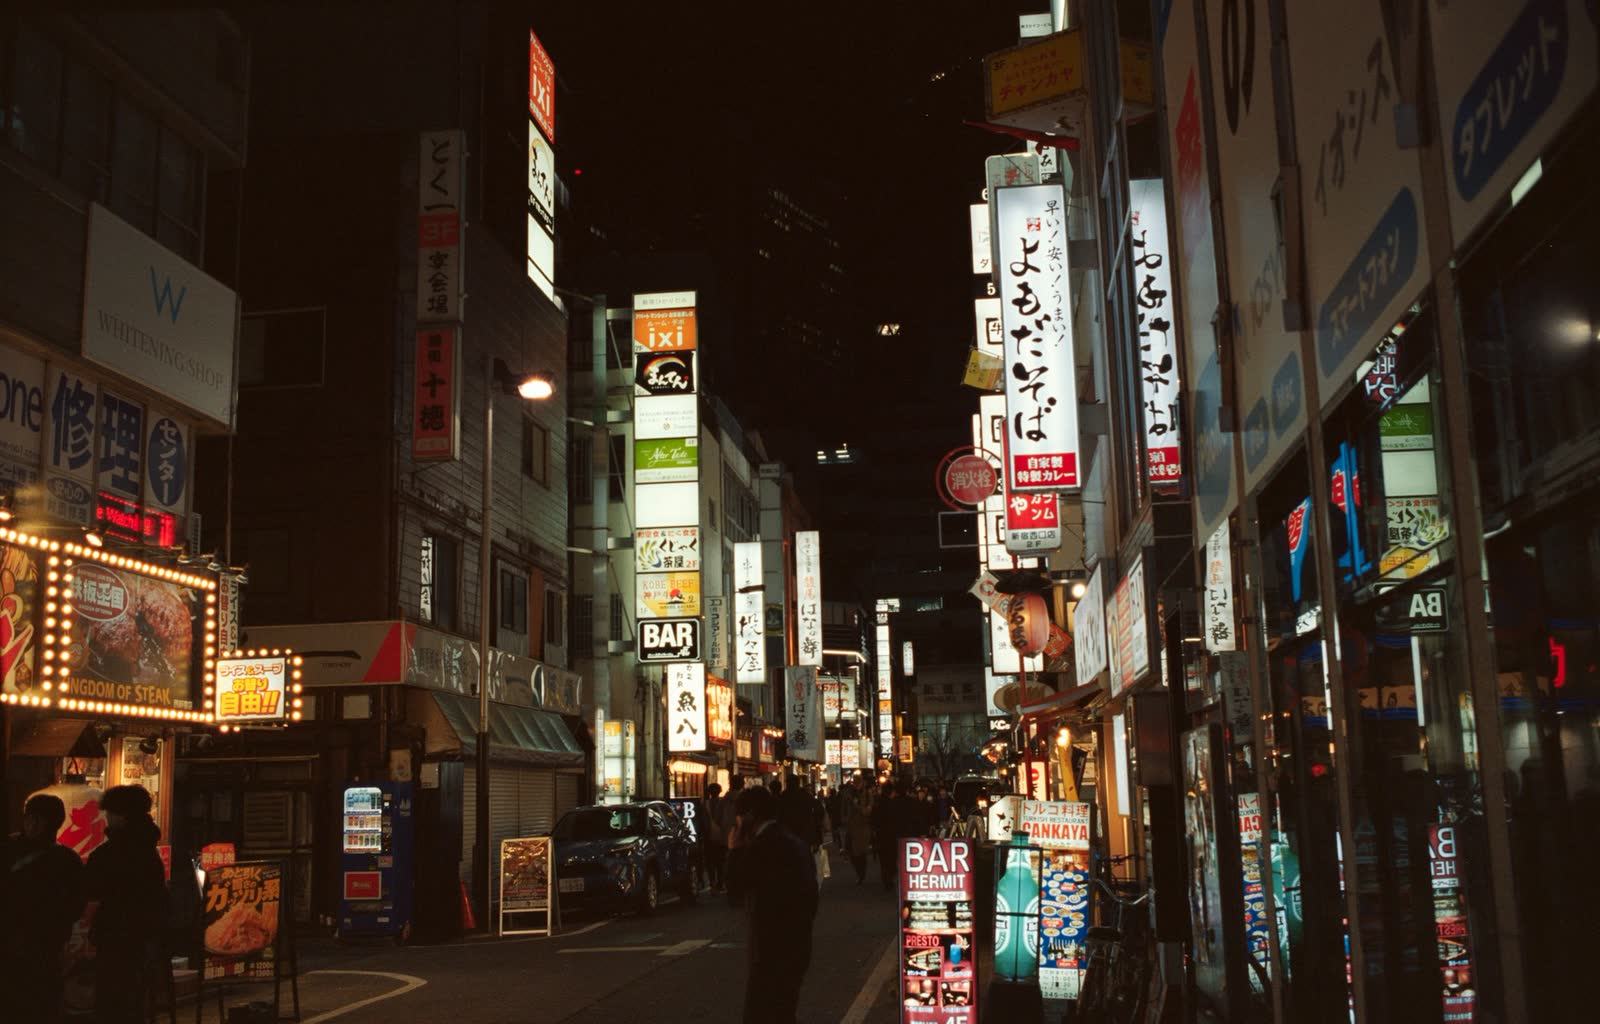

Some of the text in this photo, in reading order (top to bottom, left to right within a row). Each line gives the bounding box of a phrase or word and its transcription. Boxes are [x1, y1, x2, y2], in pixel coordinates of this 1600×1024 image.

[531, 64, 552, 119] ixi
[1459, 16, 1559, 178] タブレット
[1315, 36, 1391, 217] イオシス
[422, 221, 455, 242] 3F
[150, 266, 187, 326] W
[1329, 225, 1401, 348] スマートフォン
[648, 325, 684, 349] ixi
[1009, 236, 1057, 442] よもだそば
[96, 308, 225, 392] WHITENING SHOP
[158, 419, 178, 505] センター
[1027, 455, 1064, 469] 自家製
[950, 467, 994, 491] 消火栓
[1016, 470, 1076, 484] 特製カレー
[659, 537, 698, 553] くじゃく
[1011, 530, 1056, 541] 新宿西口店
[1026, 540, 1043, 548] 2F
[663, 554, 697, 569] 茶屋 2F
[643, 579, 694, 590] KOBE BEEF
[643, 622, 694, 649] BAR
[219, 662, 283, 678] ライス&スープ
[117, 684, 132, 701] OF
[135, 684, 171, 706] STEAK
[231, 676, 269, 693] お替り
[219, 690, 281, 718] 自由!!
[676, 689, 699, 736] 魚八
[1023, 801, 1089, 818] トルコ料理
[1022, 821, 1089, 841] CANKAYA
[905, 841, 971, 874] BAR
[908, 874, 966, 889] HERMIT
[905, 935, 940, 947] PRESTO
